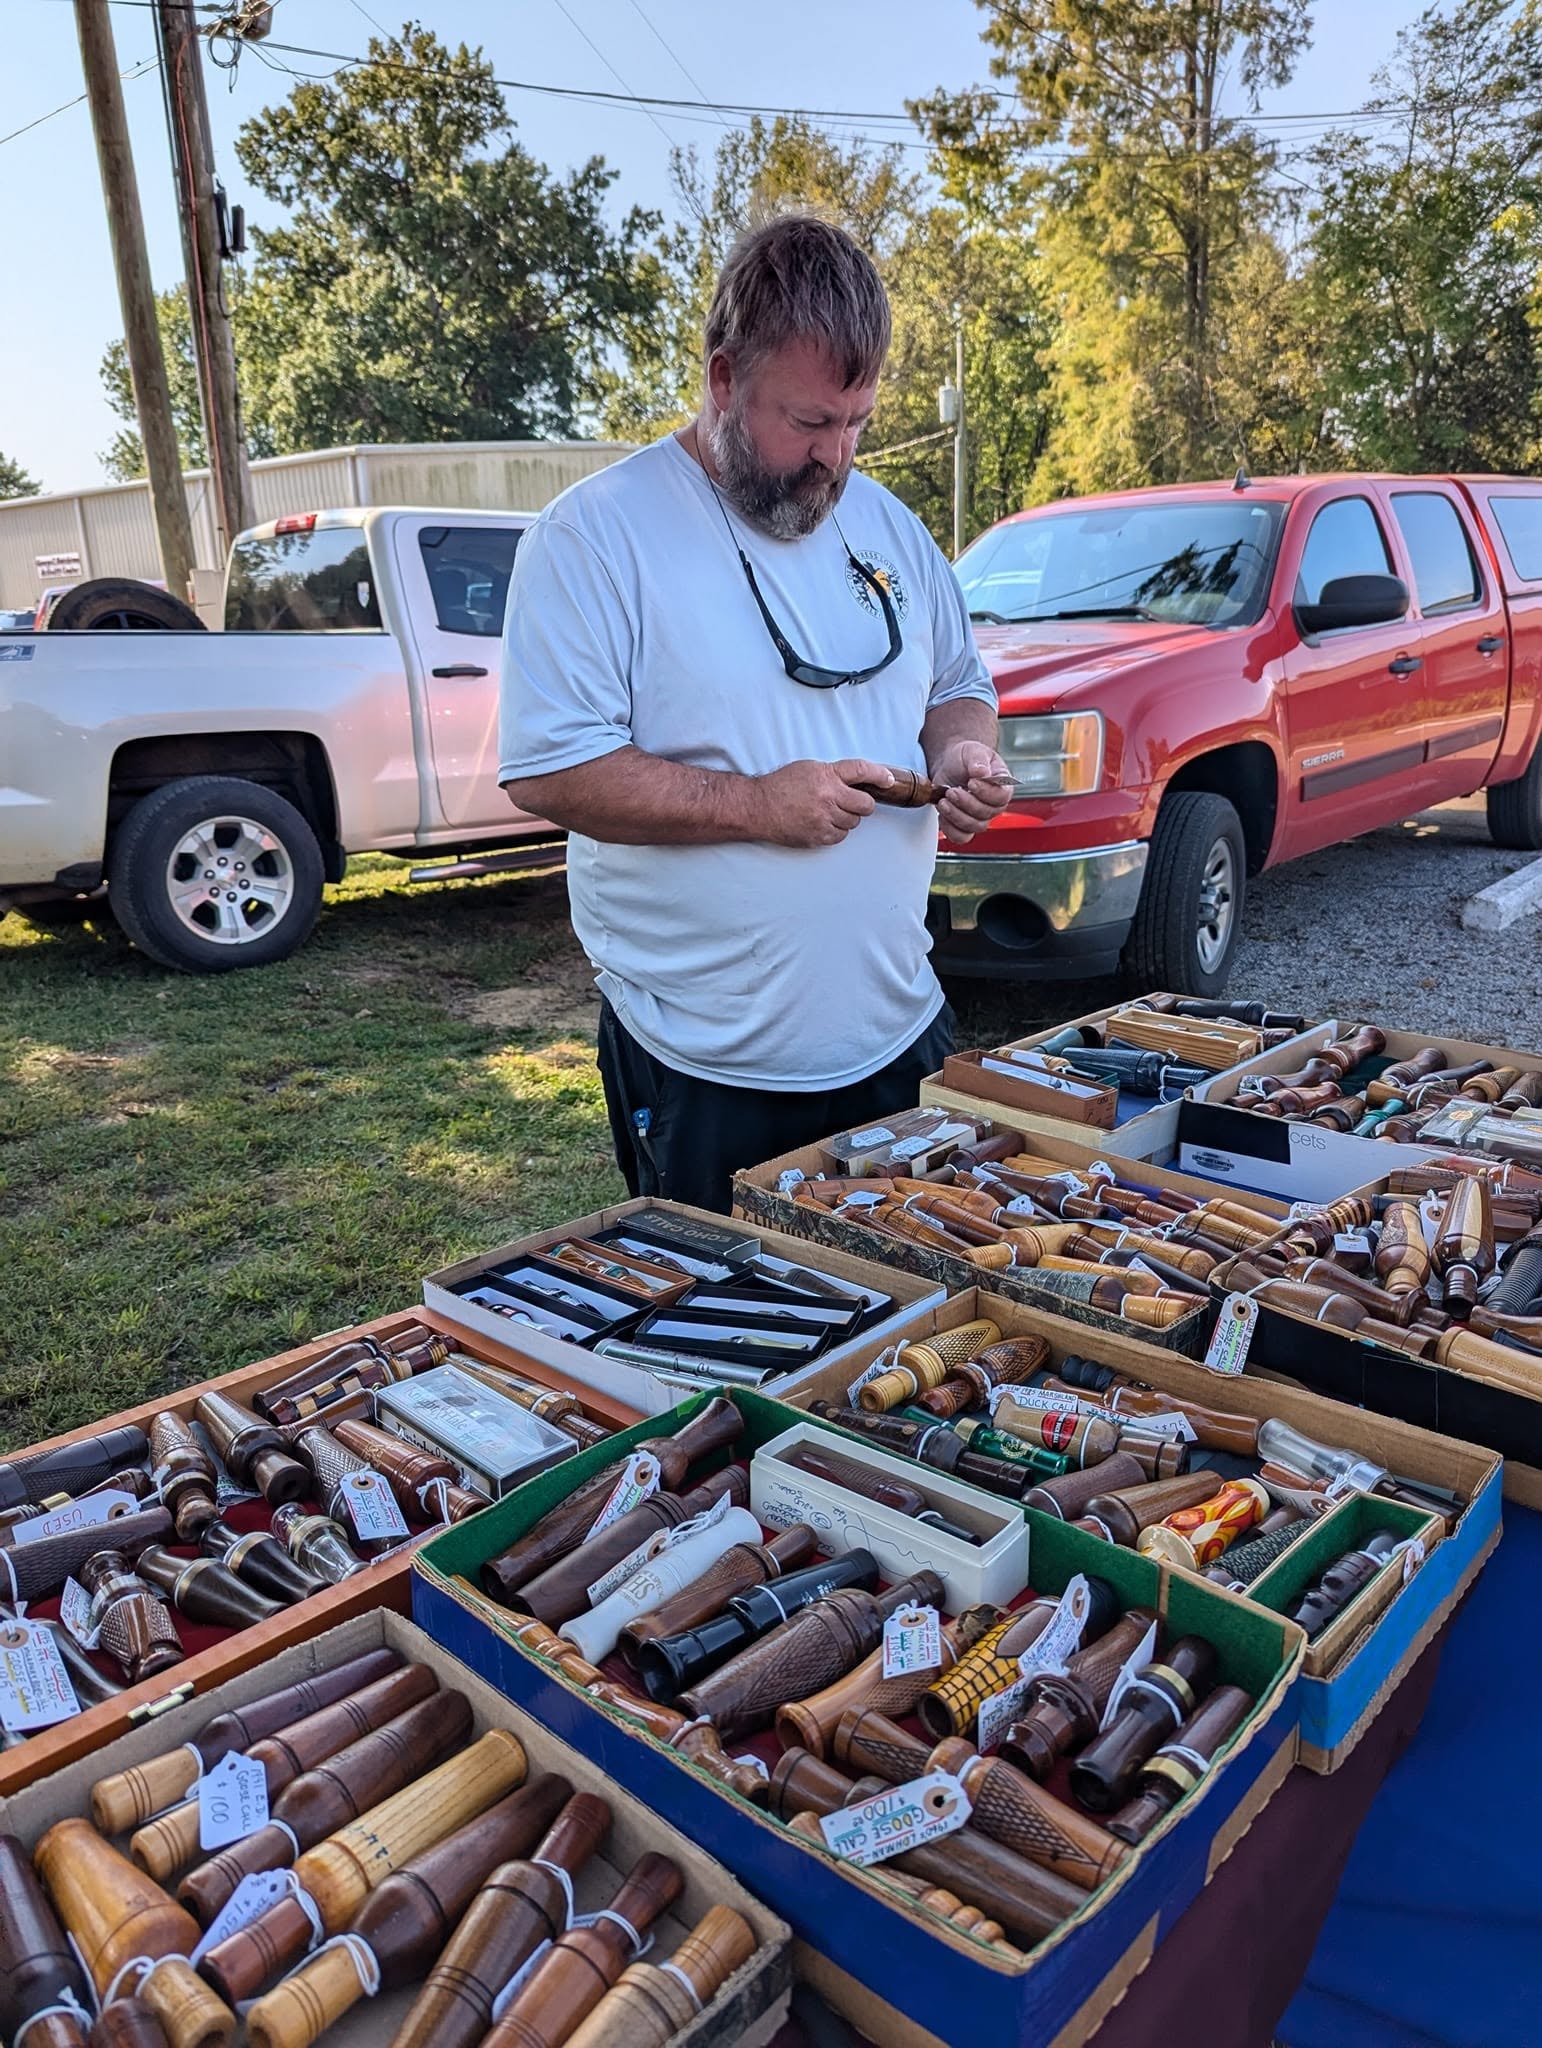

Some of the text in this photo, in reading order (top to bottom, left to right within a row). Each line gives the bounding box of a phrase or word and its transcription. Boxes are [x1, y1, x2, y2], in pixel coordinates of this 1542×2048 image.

[1301, 749, 1345, 769] SIERRA
[644, 1214, 681, 1232] CALLS
[684, 1229, 732, 1243] ECHO
[1218, 1319, 1237, 1370] GOOSE CALL
[1019, 1395, 1075, 1412] DUCK CALL
[39, 1507, 84, 1536] USED
[371, 1509, 385, 1529] CALL
[6, 1648, 26, 1685] GOOSE
[20, 1684, 36, 1714] CALL
[235, 1769, 250, 1831] GOOSE CALL
[832, 1805, 926, 1854] GOOSE CALL
